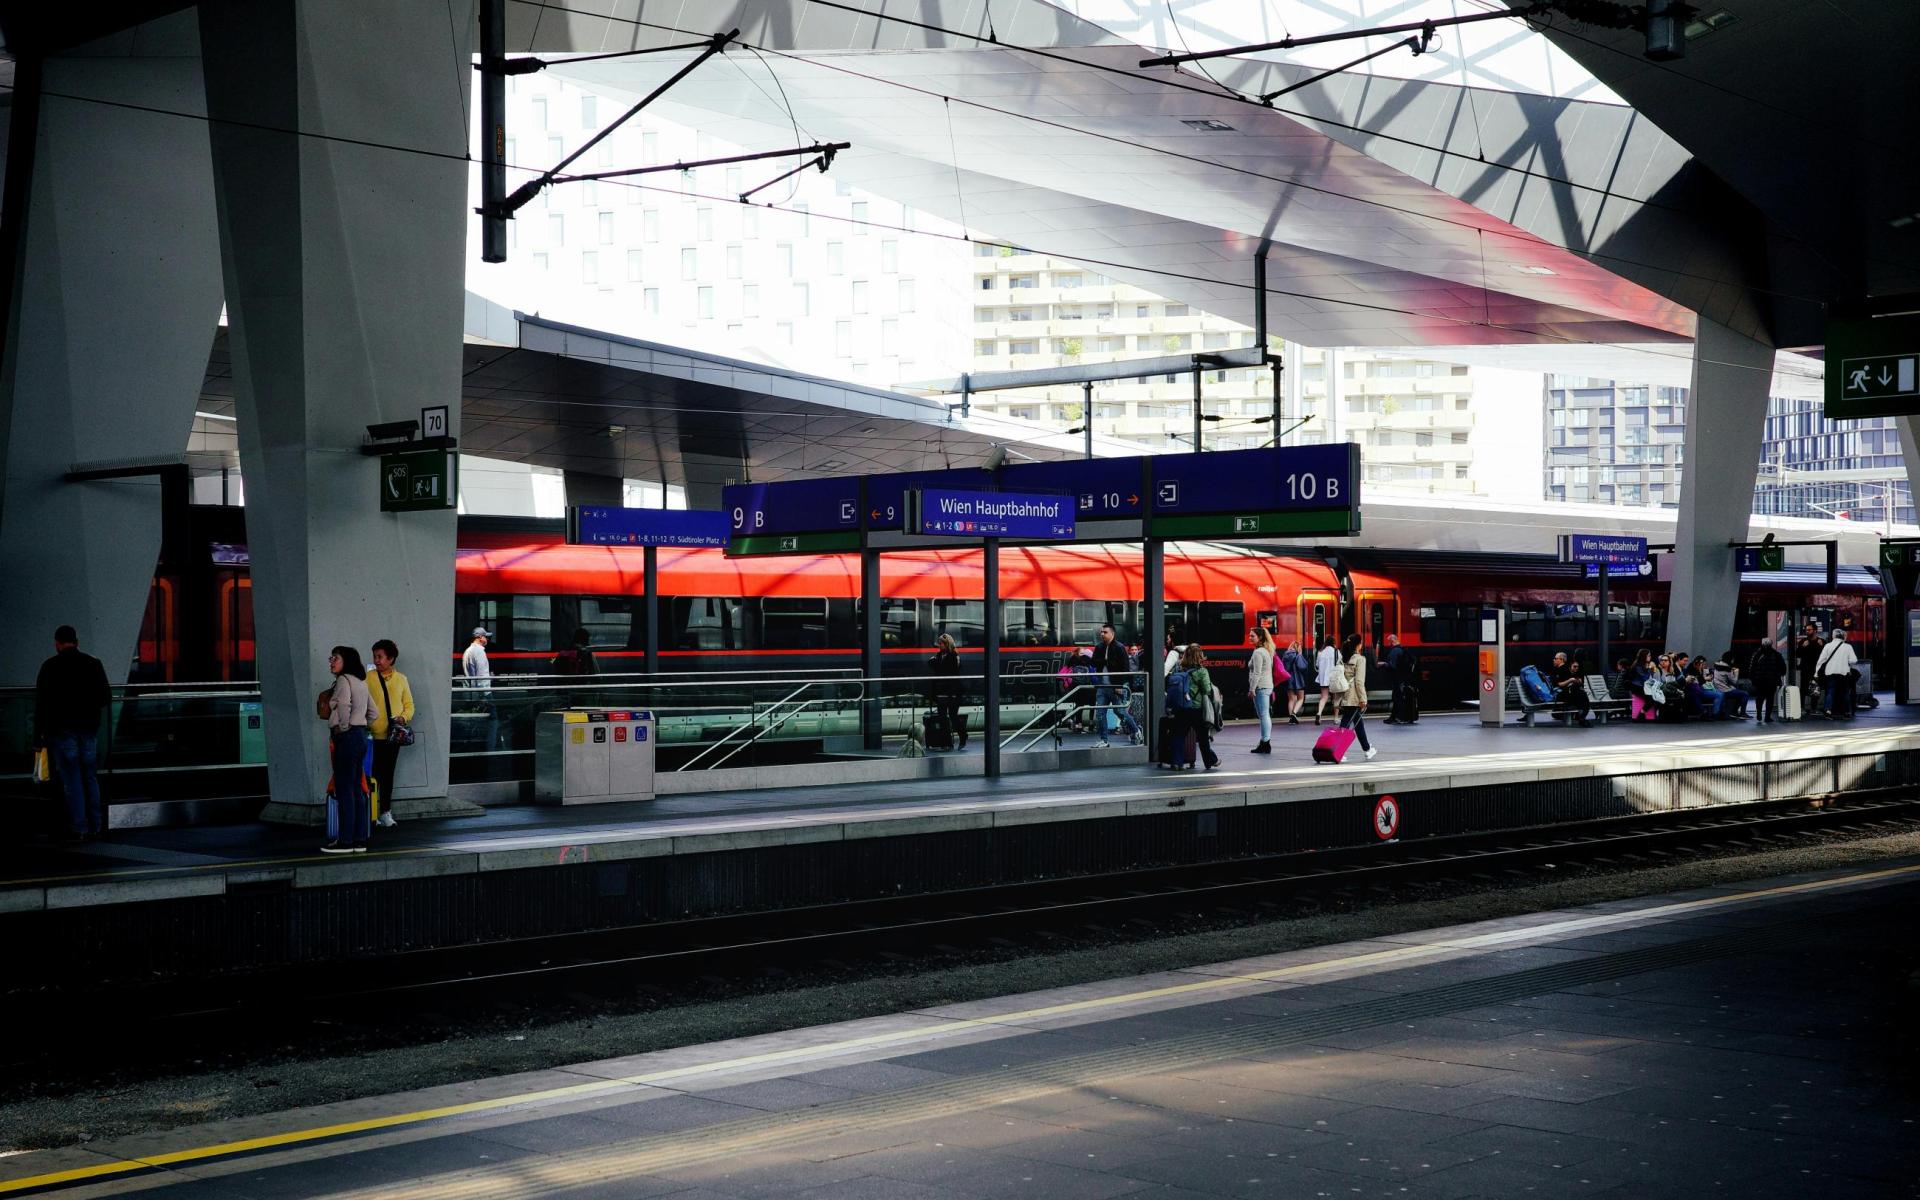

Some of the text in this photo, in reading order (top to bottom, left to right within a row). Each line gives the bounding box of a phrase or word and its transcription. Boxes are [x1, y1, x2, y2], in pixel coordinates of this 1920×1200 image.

[429, 415, 442, 431] 70
[393, 467, 407, 477] SOS
[1286, 473, 1339, 500] 10 B
[1101, 492, 1120, 509] 10
[887, 506, 895, 520] 9
[940, 498, 1059, 519] Wien Hauptbahnhof
[733, 507, 764, 529] 9 B
[651, 535, 667, 543] 11-12
[677, 536, 705, 544] Südtiroler
[1582, 540, 1639, 552] Wien Hauptbahnhof
[1315, 613, 1323, 624] 2
[1373, 613, 1382, 623] 2
